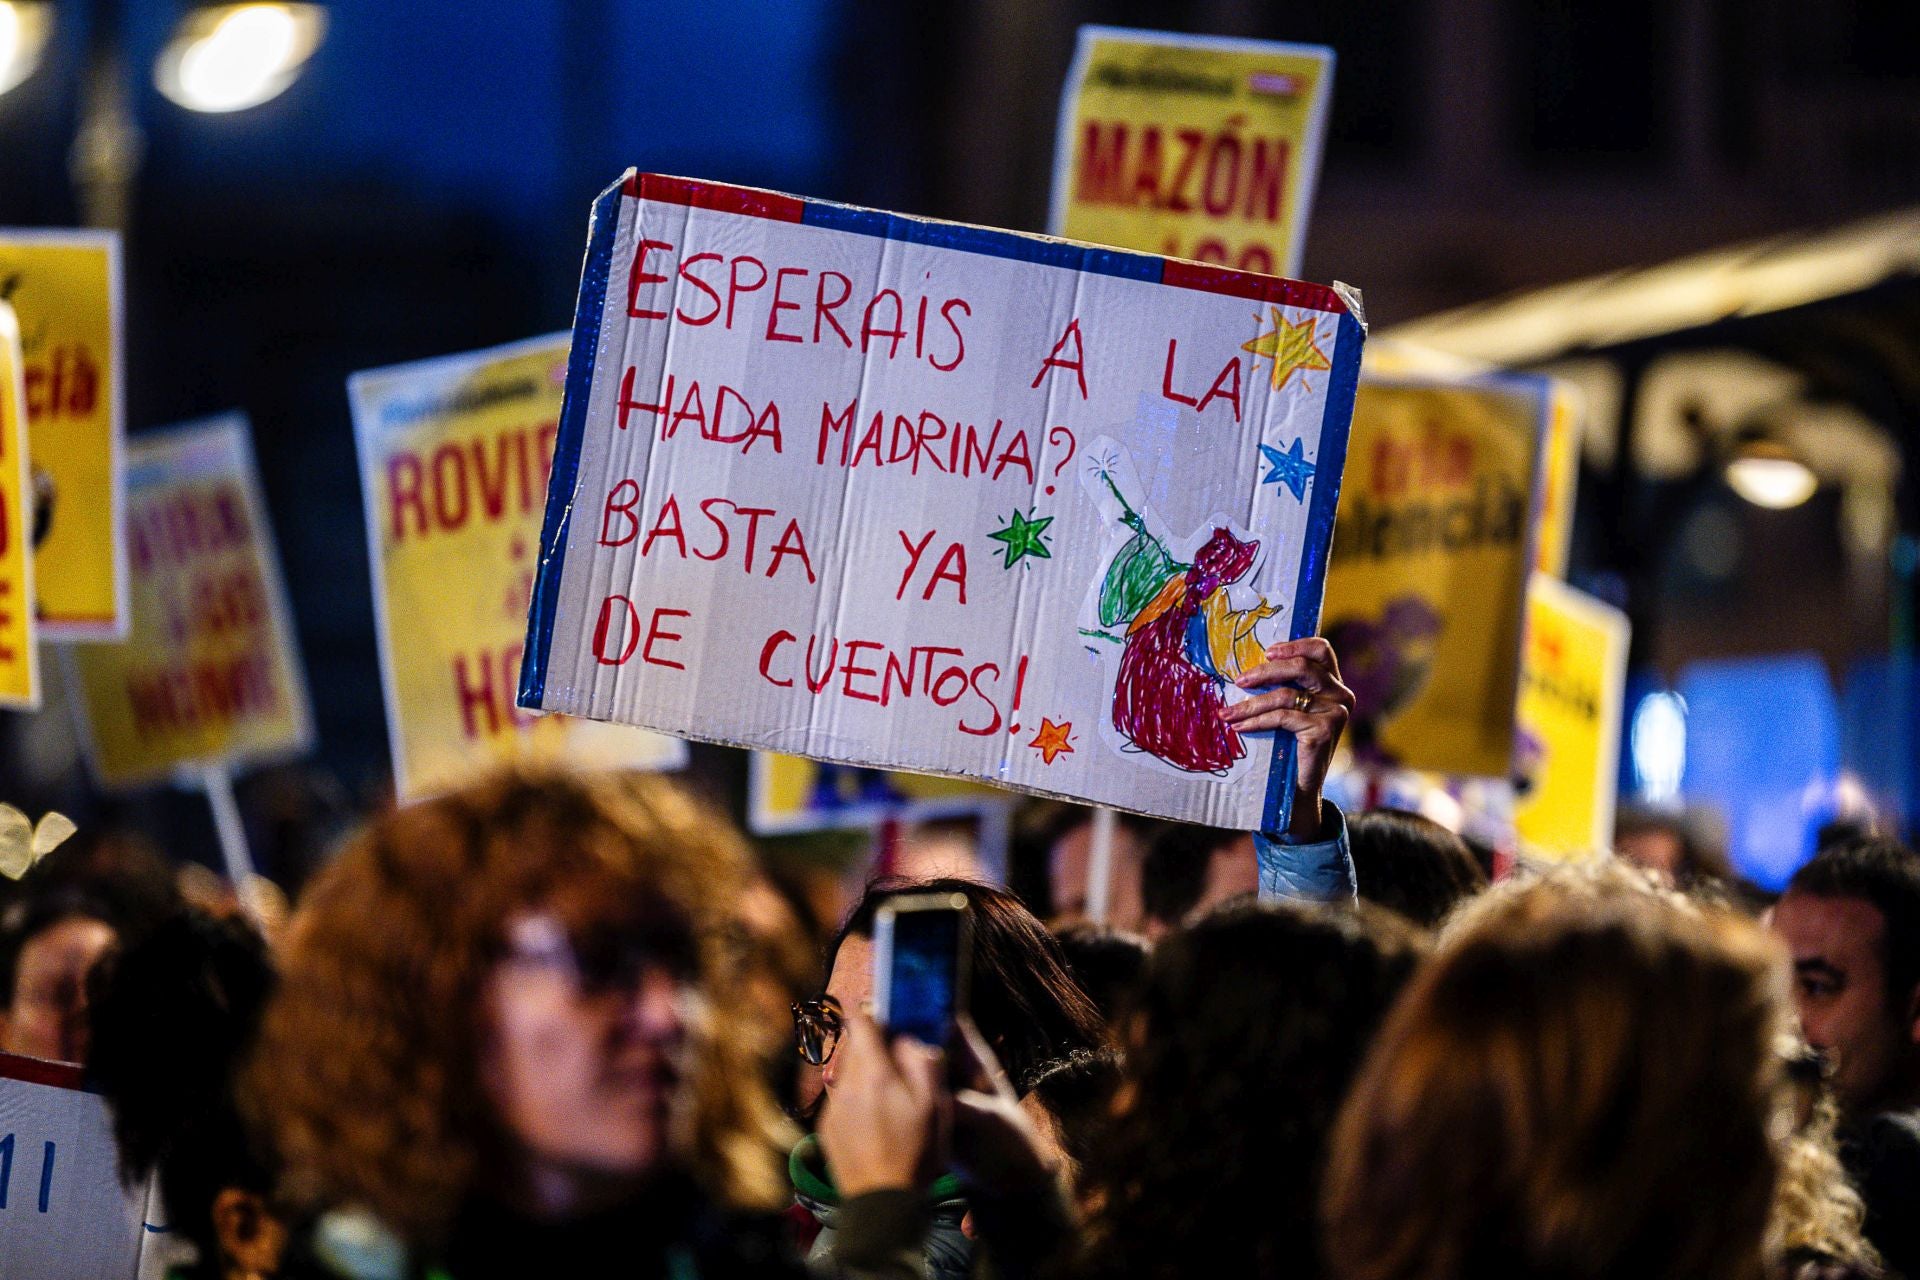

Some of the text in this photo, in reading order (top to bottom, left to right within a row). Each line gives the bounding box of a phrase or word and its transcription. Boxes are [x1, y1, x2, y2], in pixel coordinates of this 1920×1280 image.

[1077, 114, 1290, 227] MAZÓN
[617, 366, 783, 455] HADA
[816, 397, 1077, 496] MADRINA?
[1032, 318, 1088, 400] A
[1162, 338, 1241, 423] LA
[596, 478, 816, 584] BASTA
[896, 529, 968, 605] YA
[592, 595, 1029, 736] DE CUENTOS!
